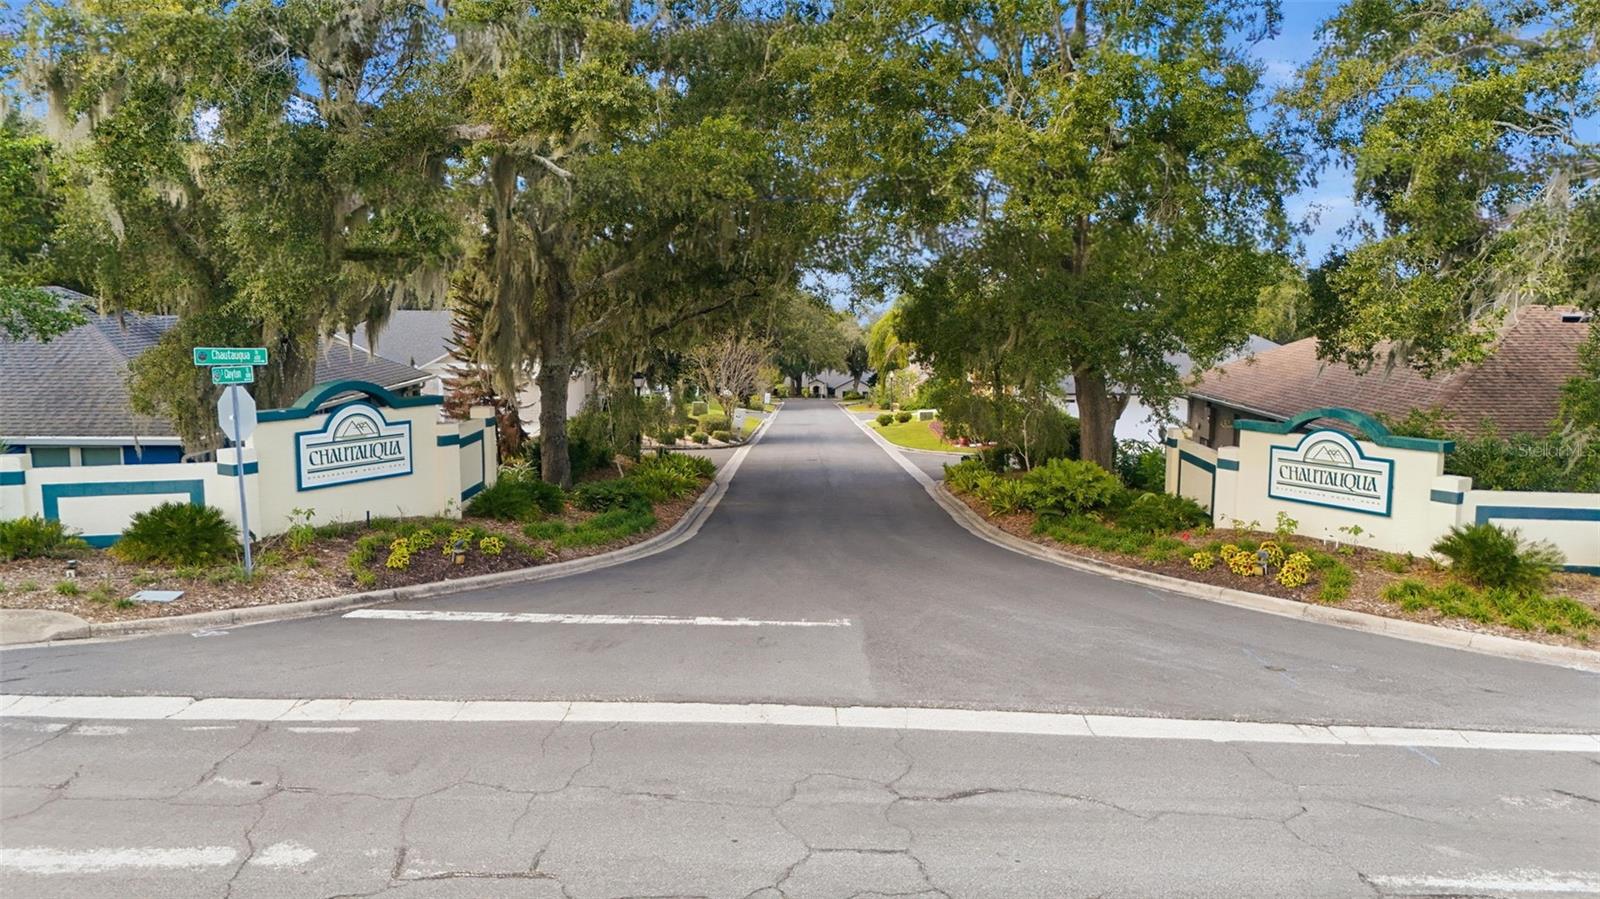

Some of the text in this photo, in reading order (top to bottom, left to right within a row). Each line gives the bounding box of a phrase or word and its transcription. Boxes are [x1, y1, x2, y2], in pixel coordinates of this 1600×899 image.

[211, 349, 250, 362] Chautauqua
[308, 440, 402, 466] CHAUTAUQUA
[1279, 464, 1378, 493] CHAUTAUQUA
